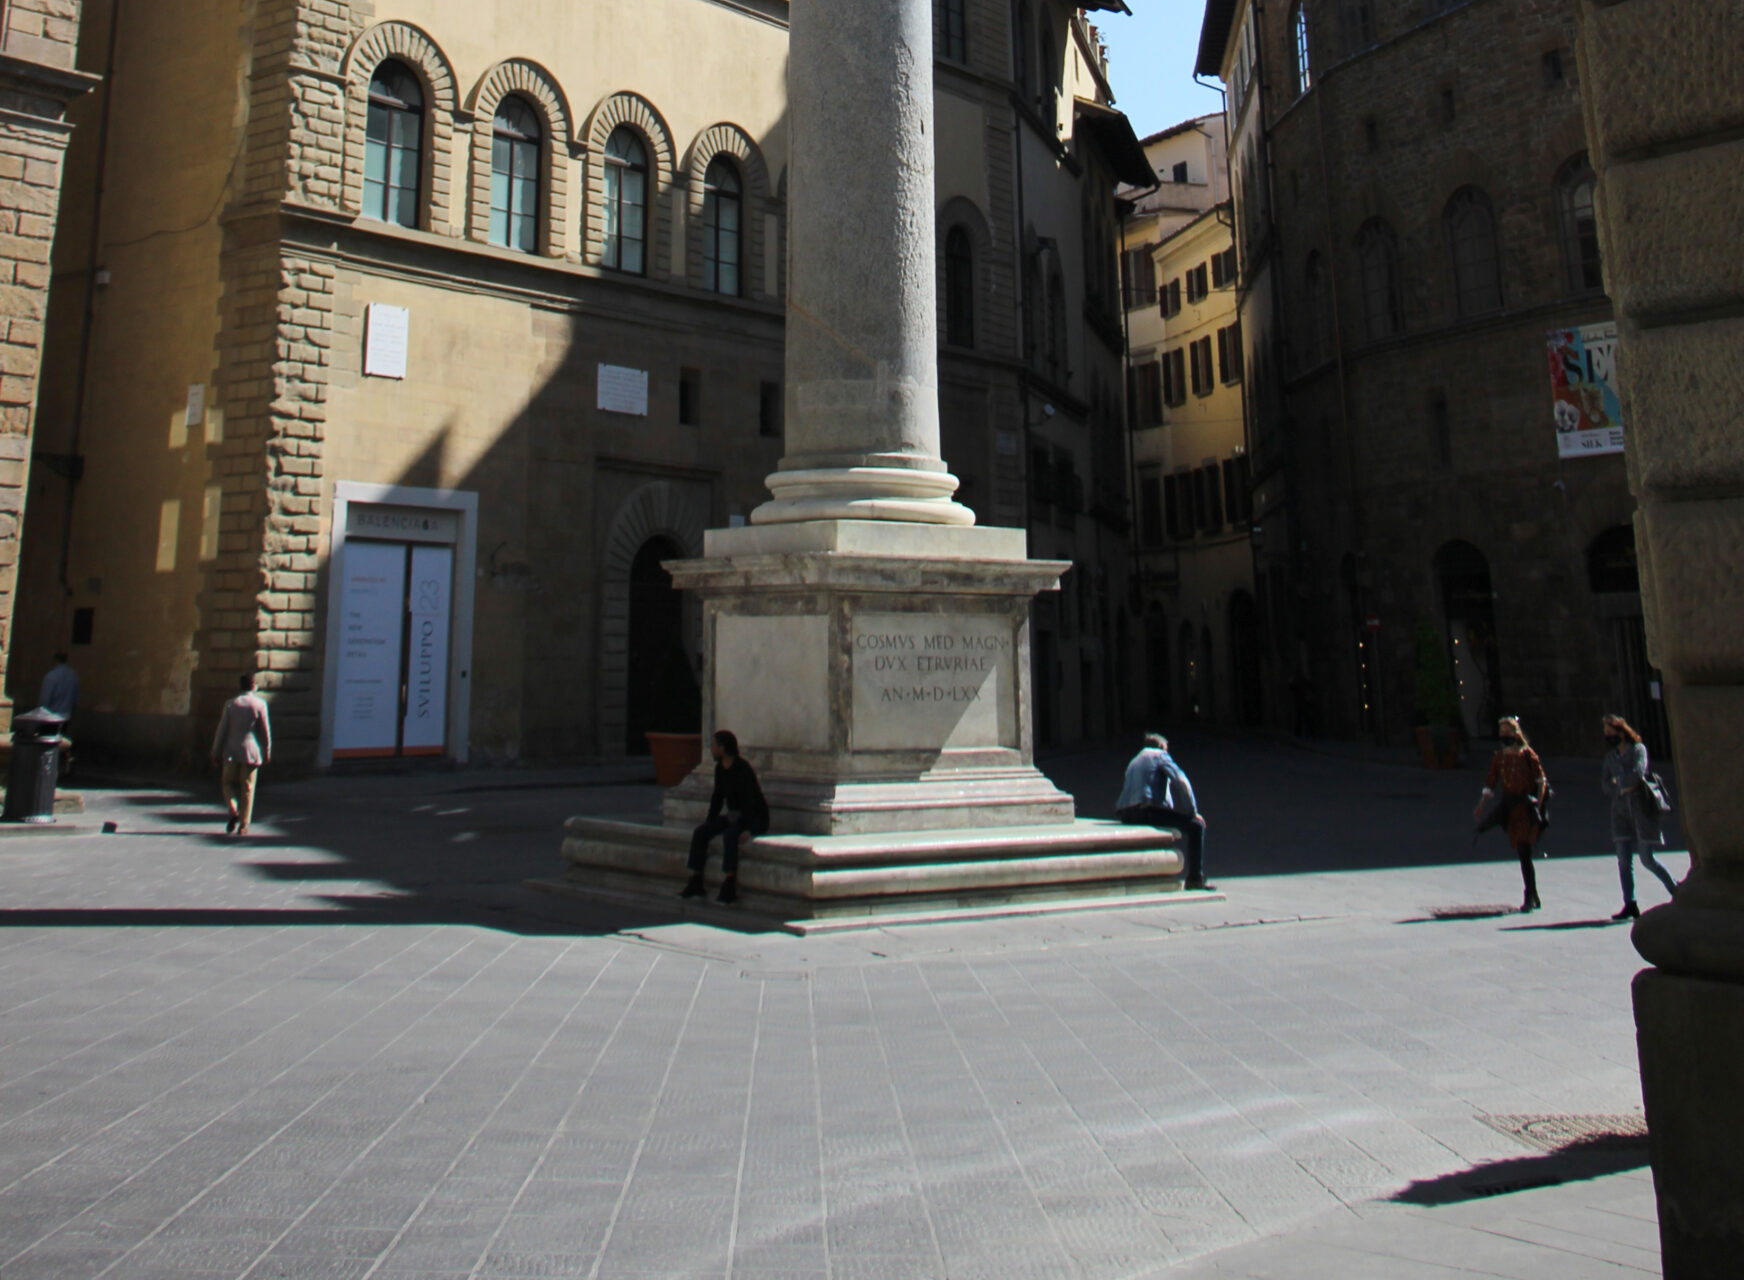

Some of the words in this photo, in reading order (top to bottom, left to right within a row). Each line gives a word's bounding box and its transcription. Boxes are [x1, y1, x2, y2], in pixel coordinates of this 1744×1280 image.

[419, 579, 440, 611] 23
[856, 634, 915, 650] COSMVS
[924, 634, 954, 650] MED
[417, 620, 434, 719] SVILUPPO
[874, 655, 907, 671] DVX
[917, 655, 986, 671] ETRVRIAE
